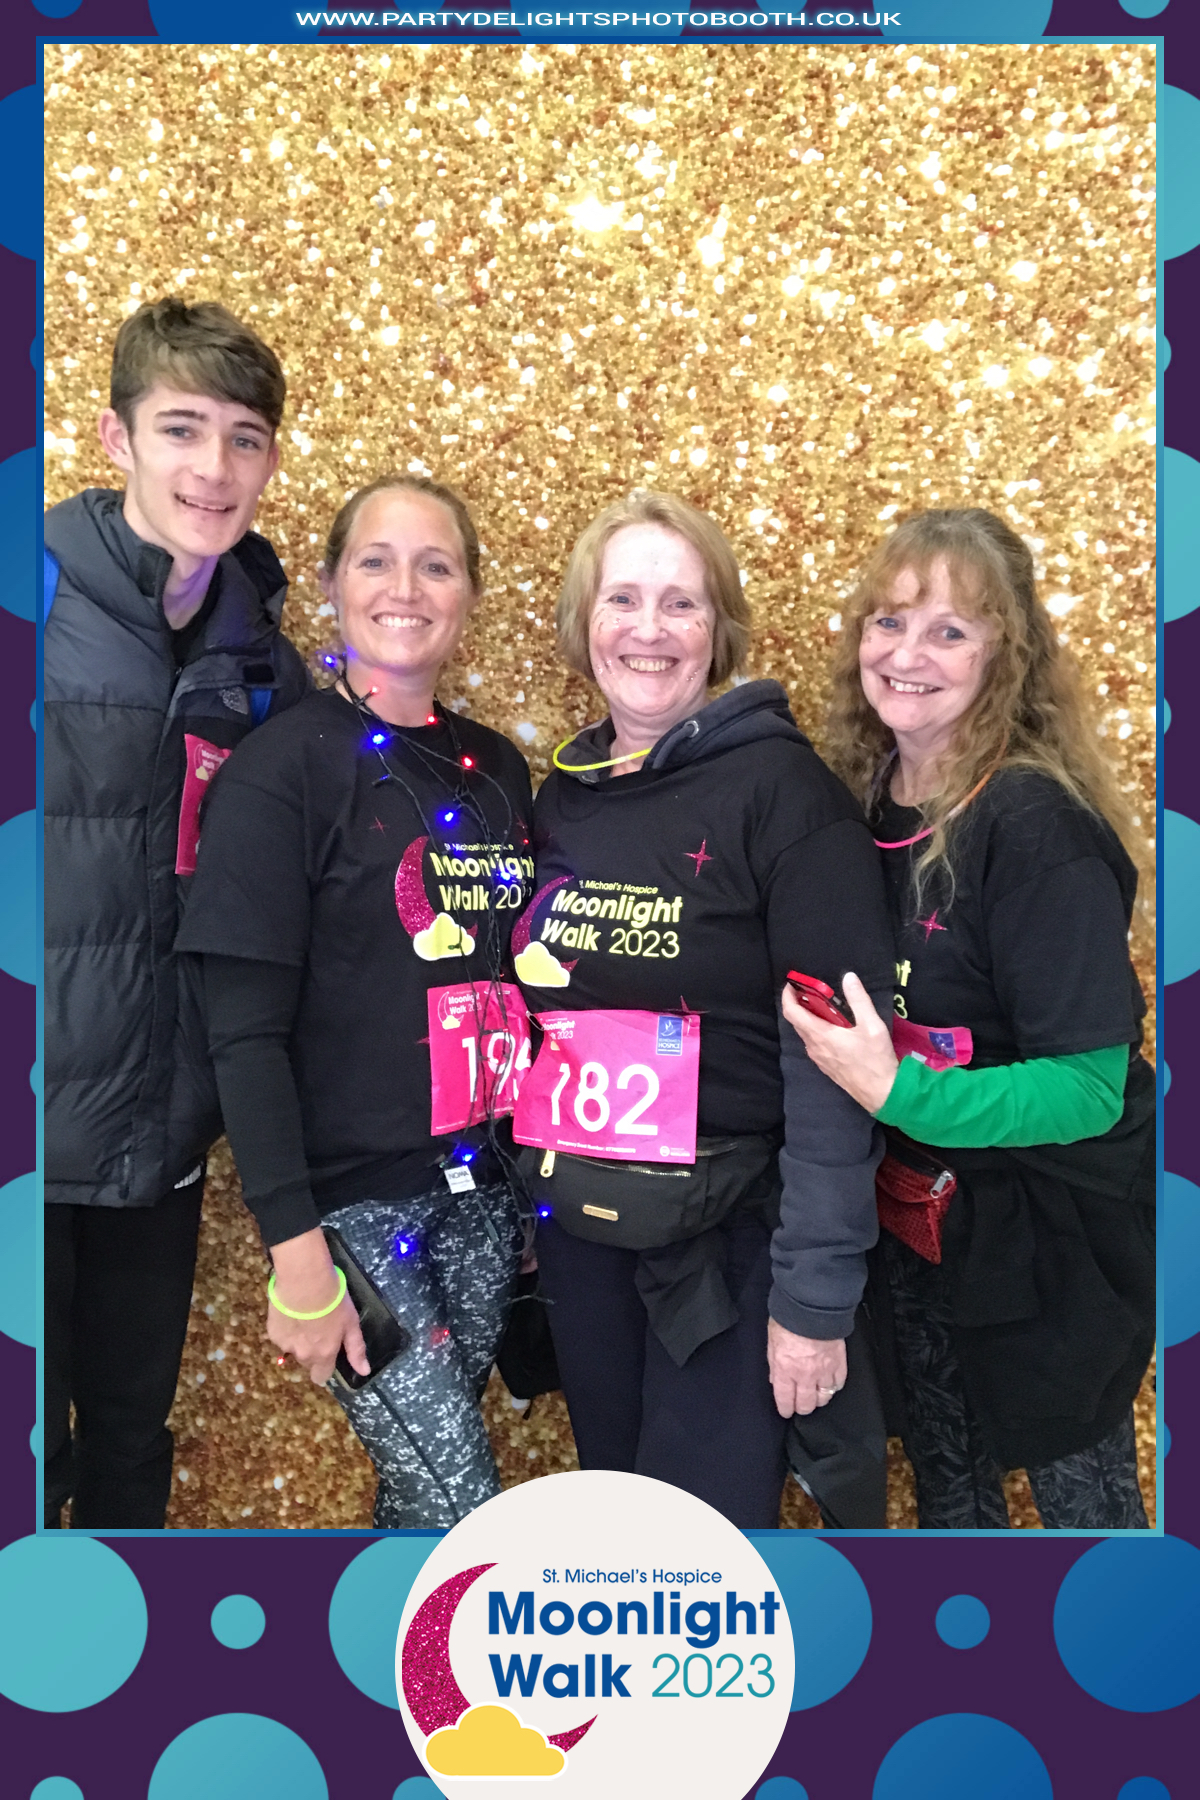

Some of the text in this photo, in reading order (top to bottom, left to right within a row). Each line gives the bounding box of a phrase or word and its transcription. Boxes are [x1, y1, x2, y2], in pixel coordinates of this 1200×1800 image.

[438, 884, 490, 911] Walk
[585, 880, 622, 891] Michael's
[623, 884, 659, 895] Hospice
[551, 889, 683, 929] Moonlight
[540, 918, 680, 959] Walk 2023
